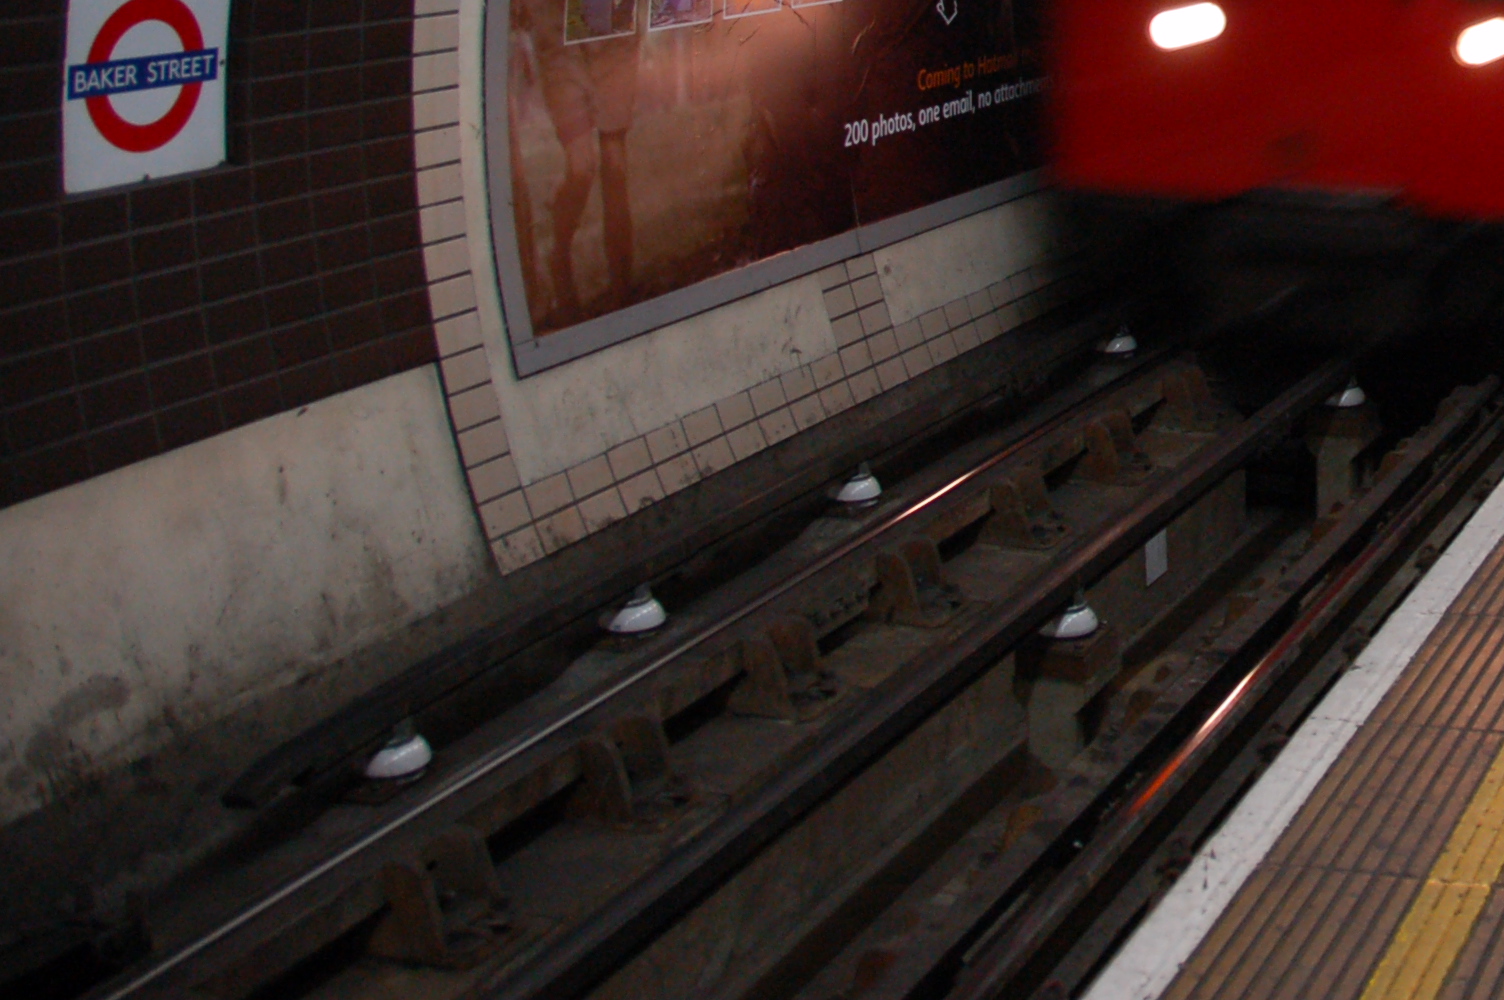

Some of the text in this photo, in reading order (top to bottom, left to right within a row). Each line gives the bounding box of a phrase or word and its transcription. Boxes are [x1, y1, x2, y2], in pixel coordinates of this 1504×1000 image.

[73, 55, 217, 93] BAKER STREET
[917, 63, 961, 91] Coming
[963, 60, 975, 79] to
[844, 116, 869, 147] 200
[872, 111, 917, 147] photos,
[918, 104, 941, 126] one
[942, 89, 976, 114] email,
[977, 90, 992, 109] no
